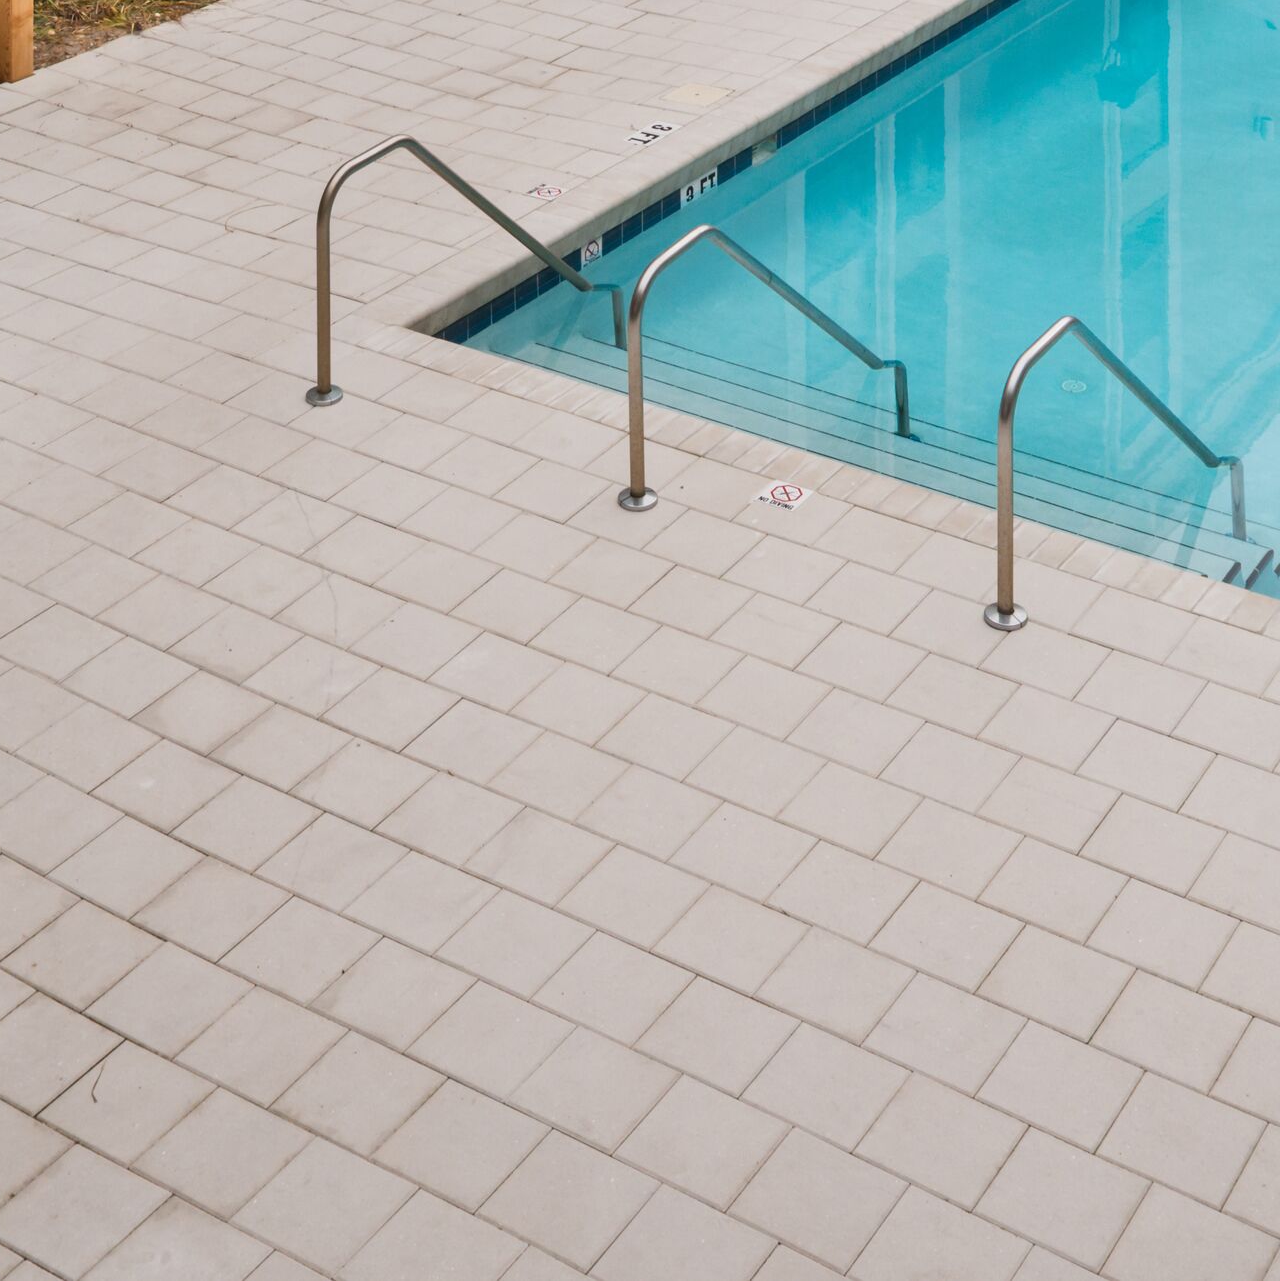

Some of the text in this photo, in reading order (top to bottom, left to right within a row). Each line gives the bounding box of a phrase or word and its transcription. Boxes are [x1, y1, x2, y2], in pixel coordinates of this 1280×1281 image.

[686, 185, 694, 202] 3
[758, 495, 794, 511] NO DIVING
